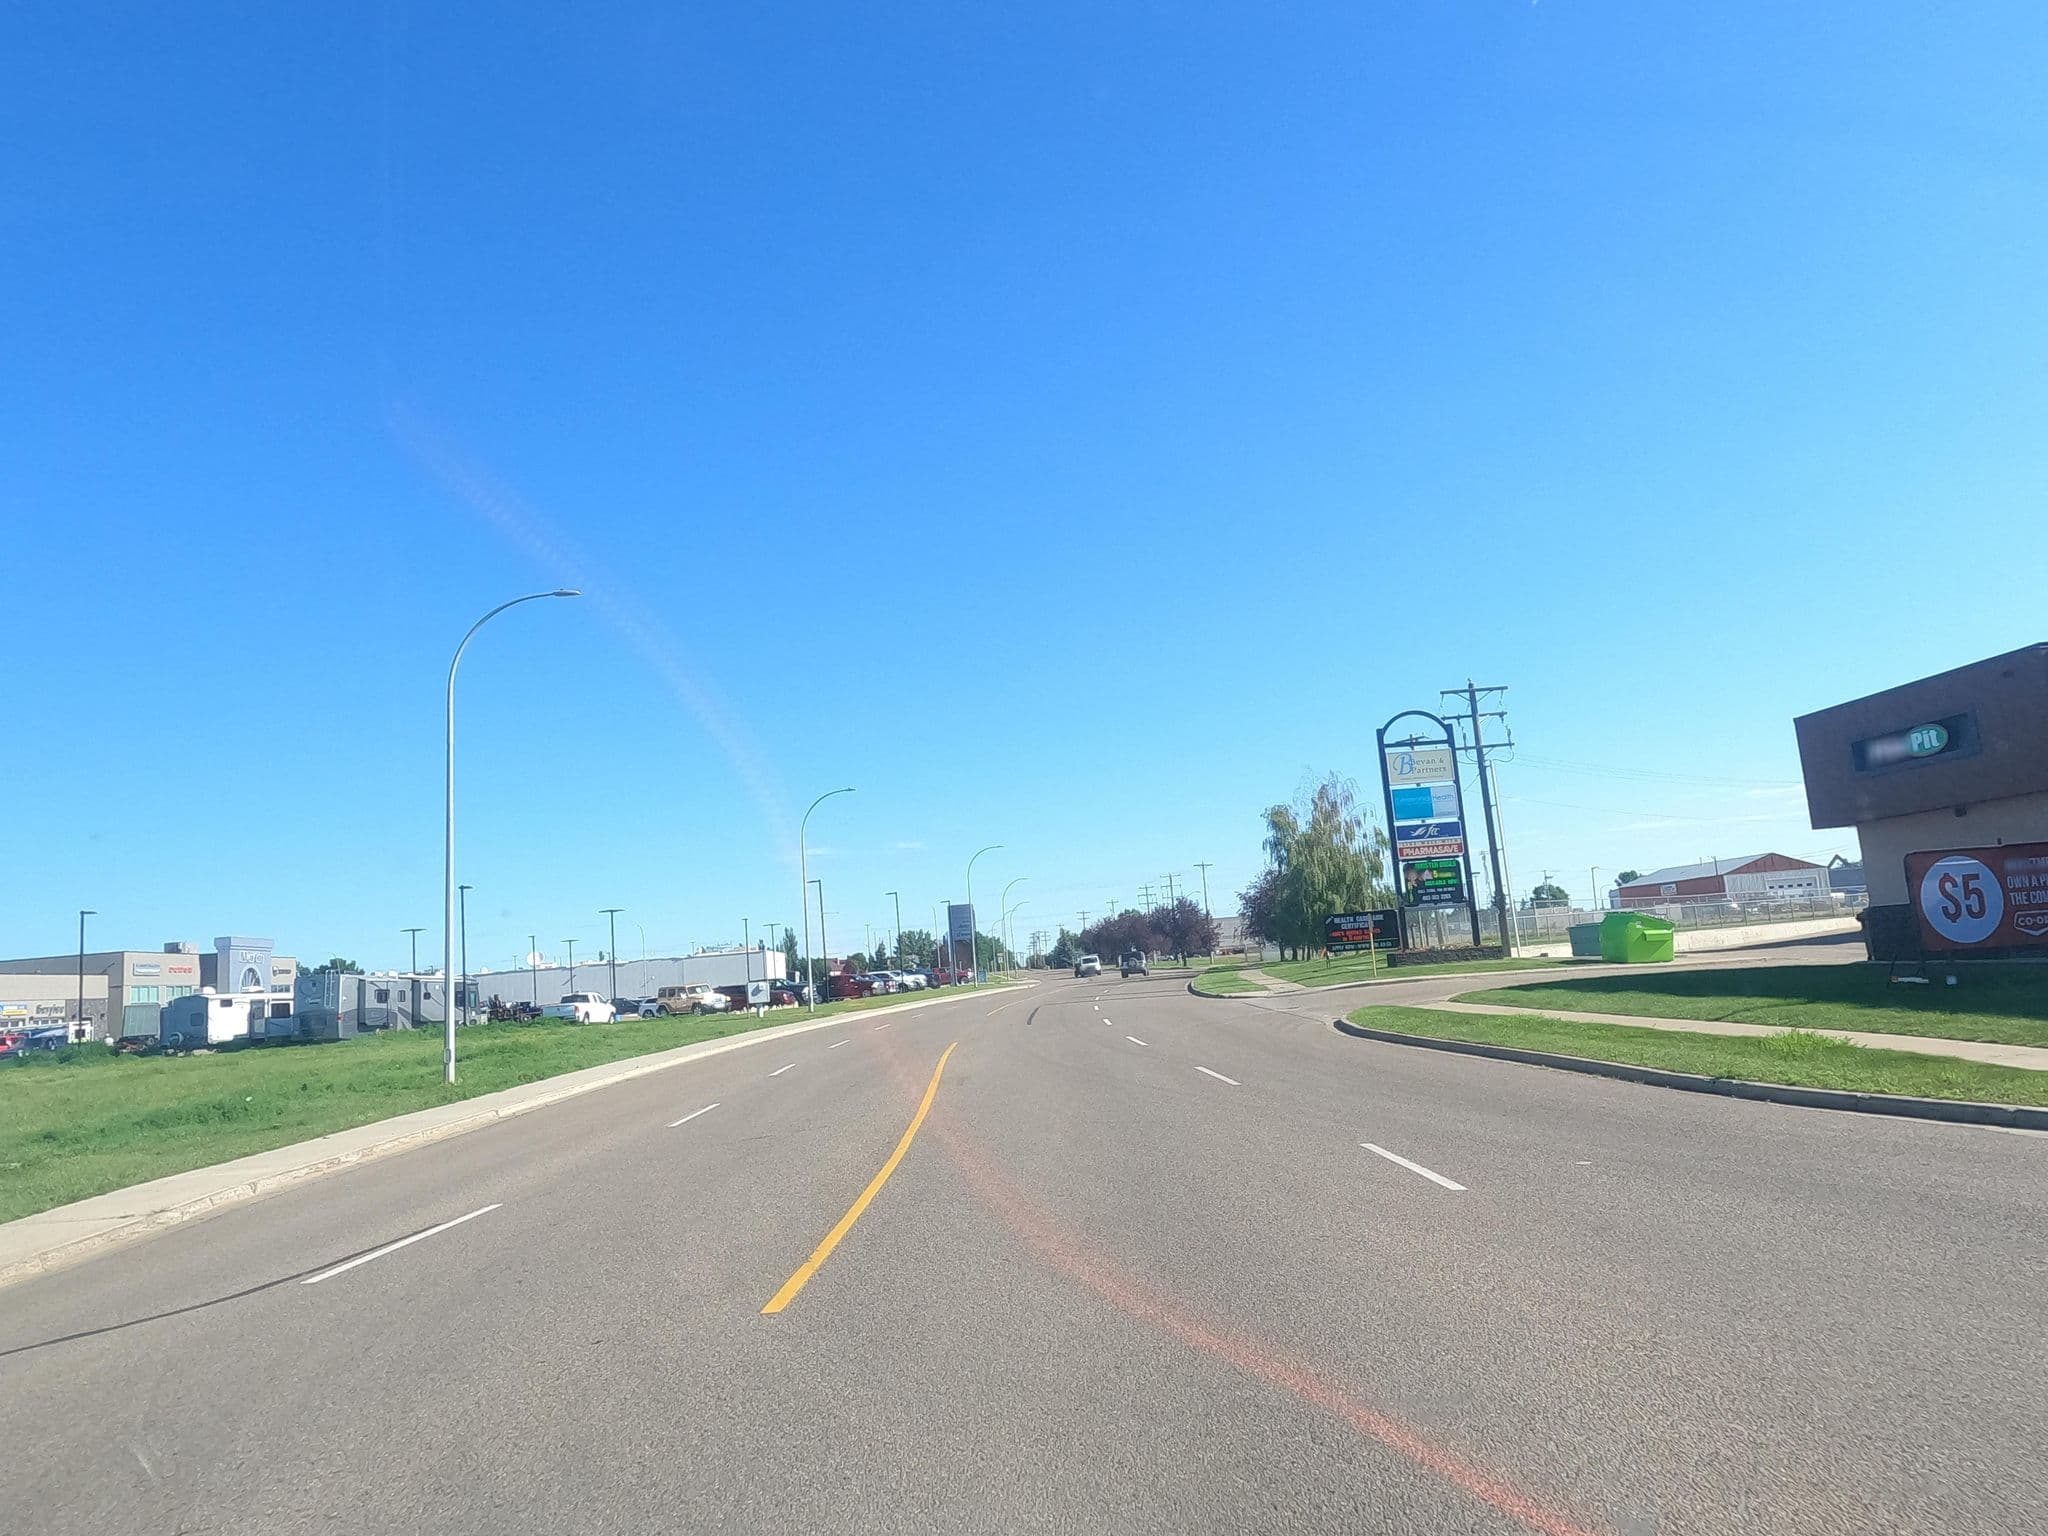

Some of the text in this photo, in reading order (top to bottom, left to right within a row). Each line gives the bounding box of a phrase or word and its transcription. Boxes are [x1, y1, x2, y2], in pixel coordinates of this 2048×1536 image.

[1911, 729, 1939, 752] Pit
[1411, 758, 1436, 766] Bevan
[1411, 766, 1447, 774] Partners
[1403, 844, 1459, 856] PHARMASAVE
[2007, 875, 2029, 888] OWN
[2031, 874, 2041, 887] A
[1938, 872, 1987, 925] $5
[2009, 892, 2028, 906] THE
